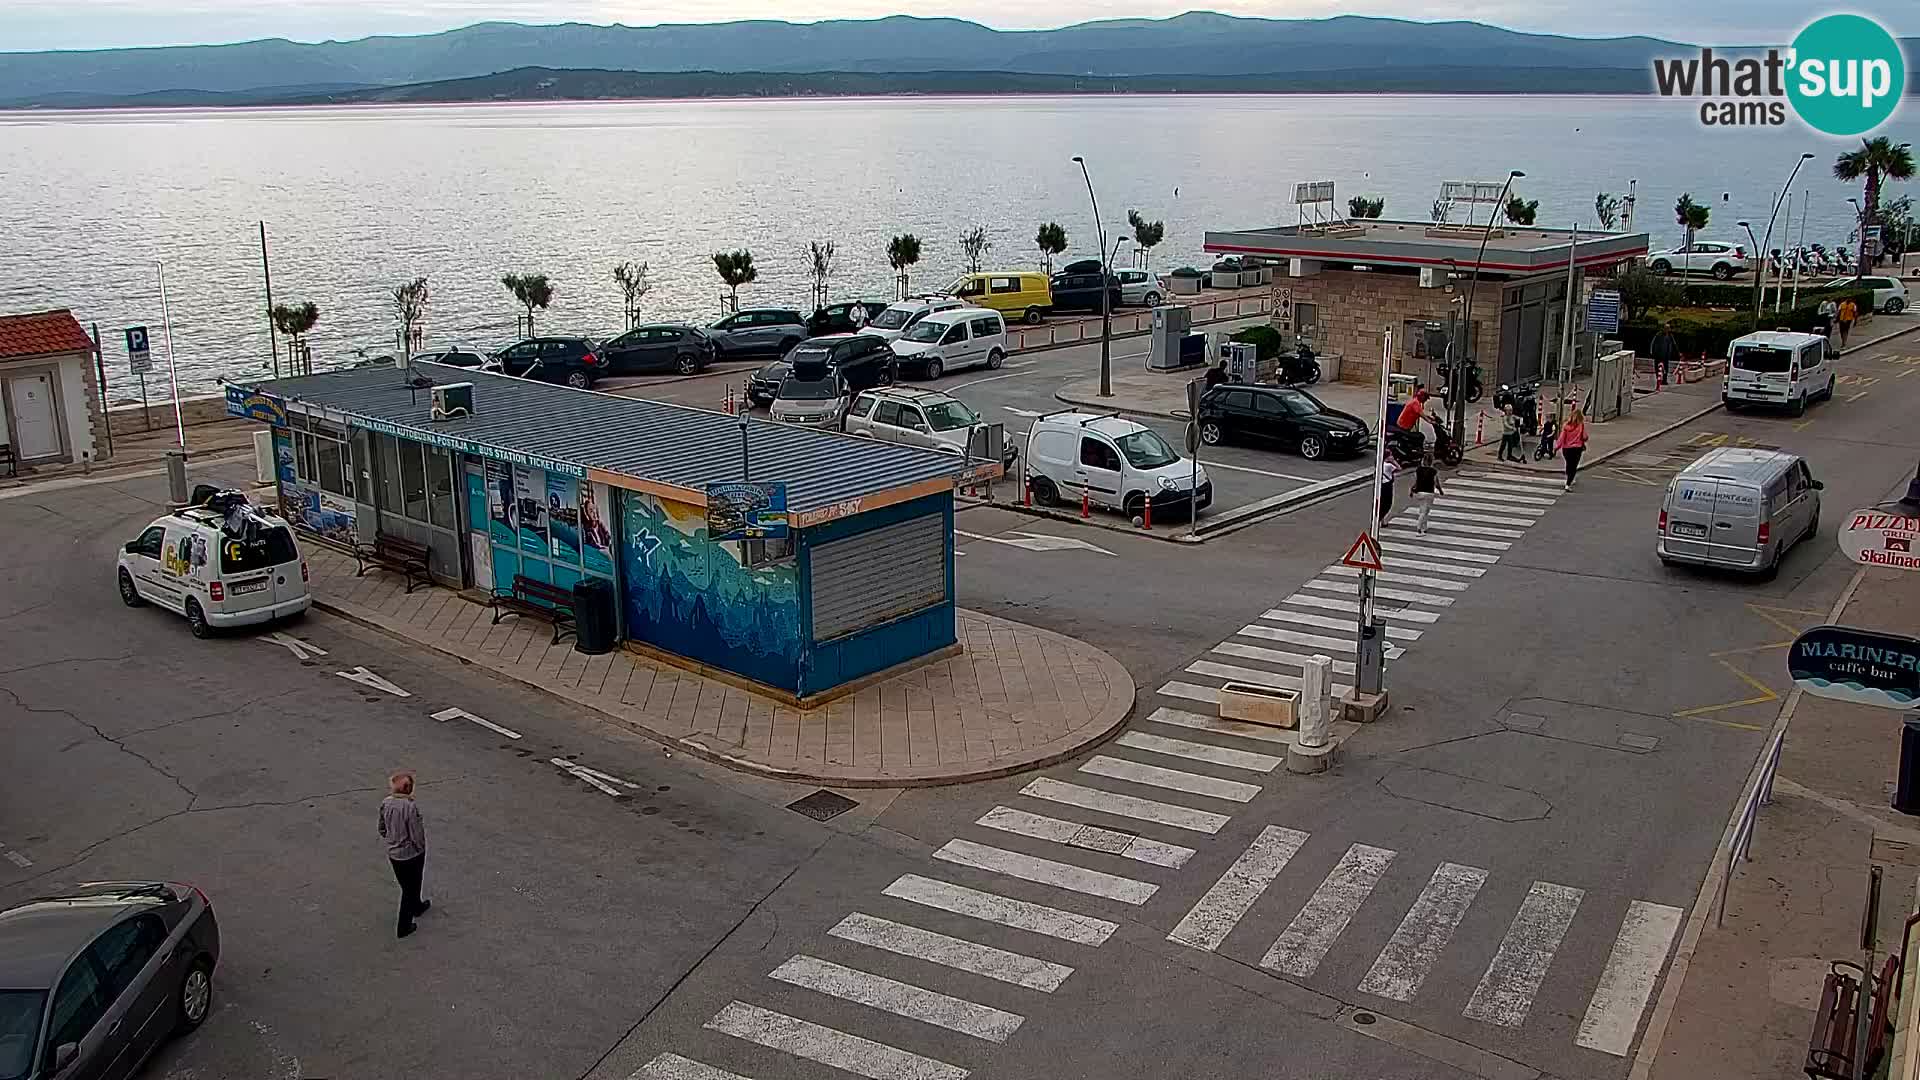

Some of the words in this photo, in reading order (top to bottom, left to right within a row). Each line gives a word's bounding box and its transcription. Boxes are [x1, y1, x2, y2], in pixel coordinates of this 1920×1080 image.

[131, 331, 143, 349] P
[397, 426, 437, 444] AUTOBUSNA
[437, 435, 469, 452] POSTAJA
[479, 445, 494, 457] BUS
[494, 449, 527, 465] STATION
[528, 456, 555, 471] TICKET
[556, 462, 583, 477] OFFICE
[1848, 513, 1920, 533] PIZZE
[1882, 530, 1916, 540] GRILL
[1829, 662, 1866, 674] caffe
[1871, 665, 1897, 679] bar
